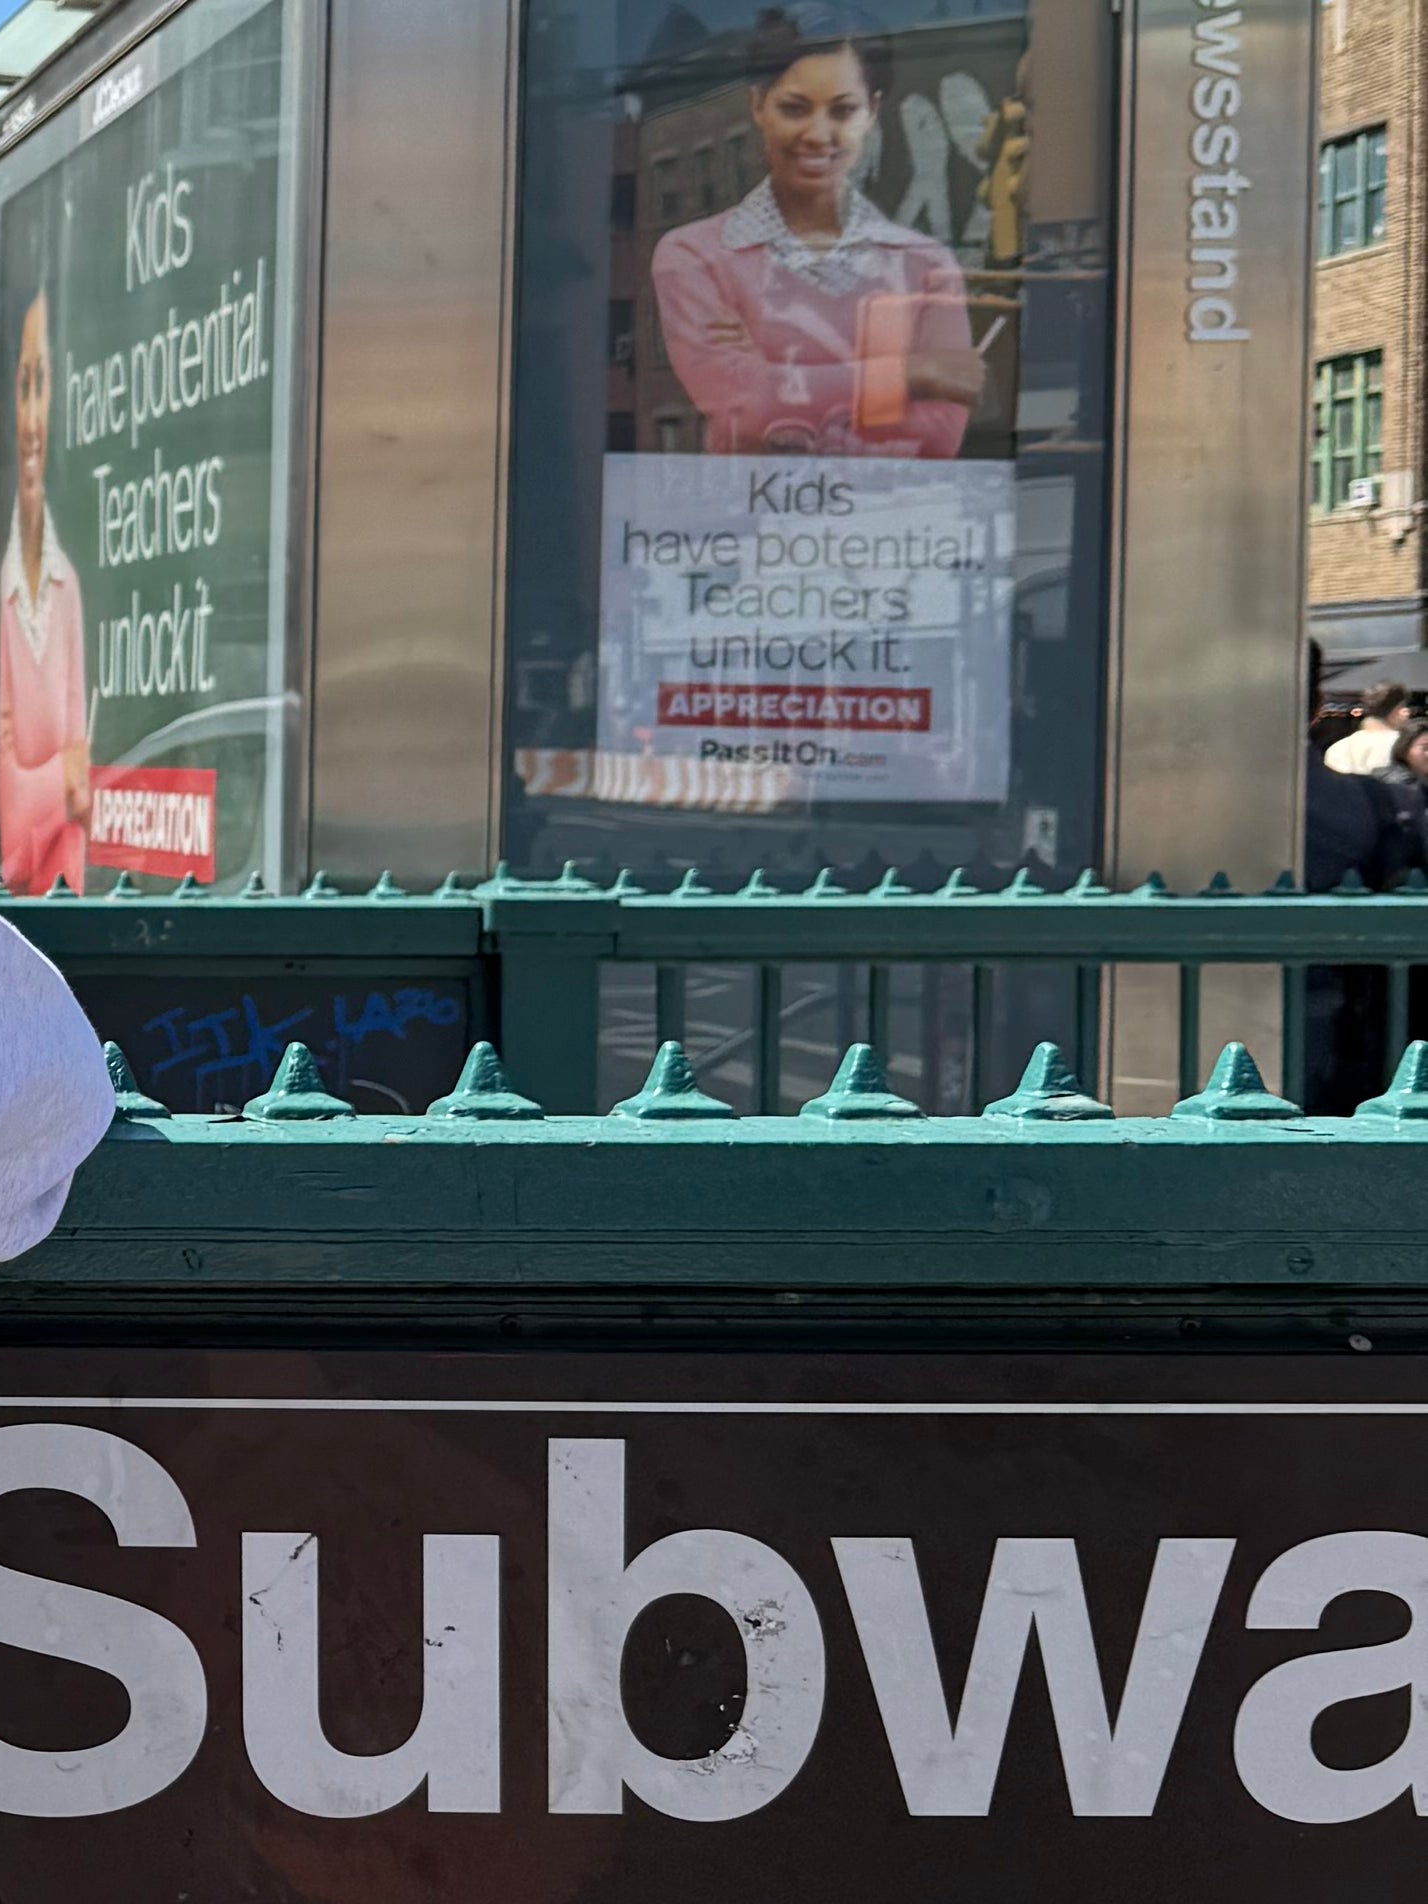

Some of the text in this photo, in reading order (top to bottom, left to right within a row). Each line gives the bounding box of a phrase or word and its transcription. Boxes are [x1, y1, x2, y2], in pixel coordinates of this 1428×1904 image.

[124, 163, 193, 291] Kids
[64, 257, 269, 449] have potential.
[93, 449, 224, 568] Teachers
[748, 471, 854, 516] Kids
[622, 520, 985, 585] have potential.
[680, 573, 910, 622] Teachers
[98, 576, 215, 699] unlock it.
[691, 627, 910, 674] unlock it.
[666, 694, 921, 723] APPRECIATION
[90, 788, 209, 856] APPRECIATION
